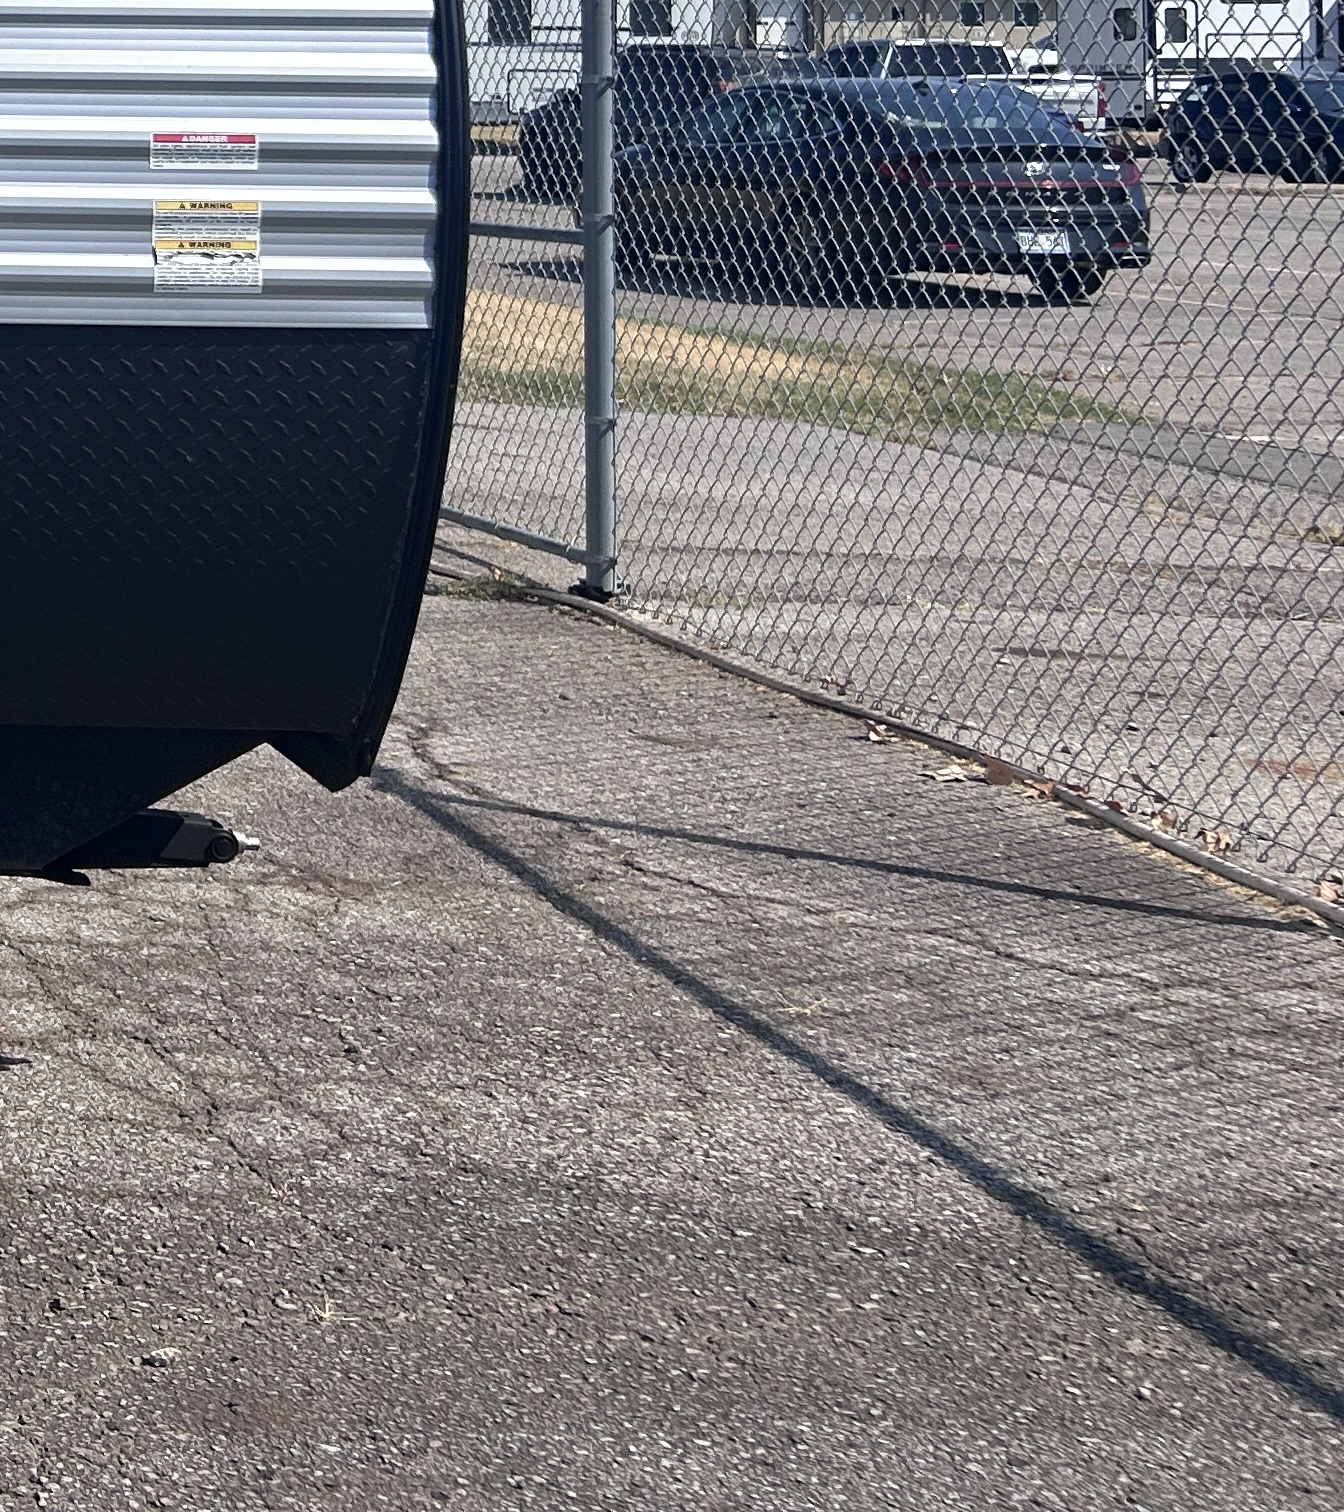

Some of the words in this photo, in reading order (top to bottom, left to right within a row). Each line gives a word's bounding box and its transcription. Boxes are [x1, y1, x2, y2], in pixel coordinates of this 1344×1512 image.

[188, 135, 229, 143] DANGER
[189, 202, 233, 210] WARNING
[188, 241, 232, 249] WARNING
